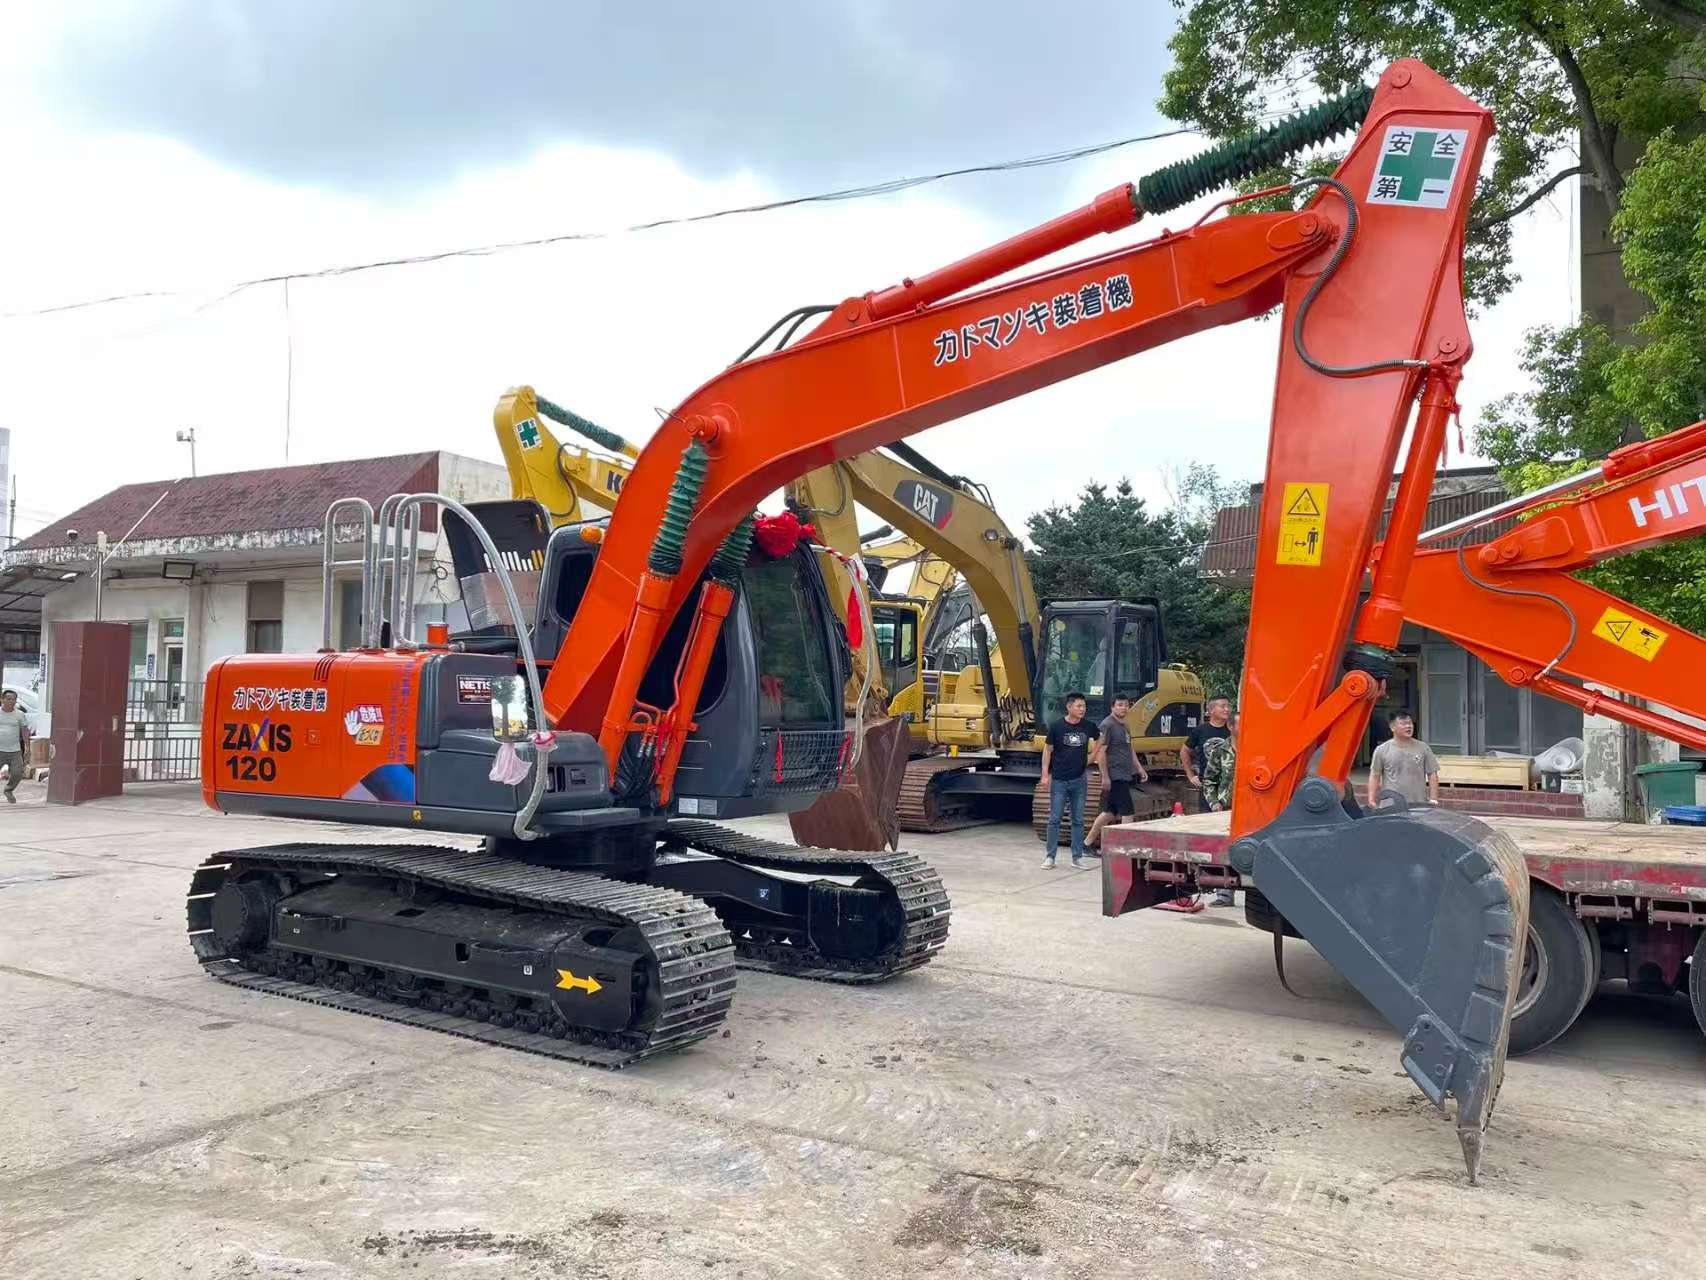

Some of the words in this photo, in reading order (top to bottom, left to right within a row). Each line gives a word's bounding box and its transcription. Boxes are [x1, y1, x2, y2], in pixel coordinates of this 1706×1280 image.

[1388, 131, 1460, 156] 安全
[1374, 176, 1445, 199] 第一
[913, 483, 939, 523] CAT
[222, 716, 292, 753] ZAXIS
[1161, 715, 1173, 734] CAT
[226, 754, 277, 783] 120
